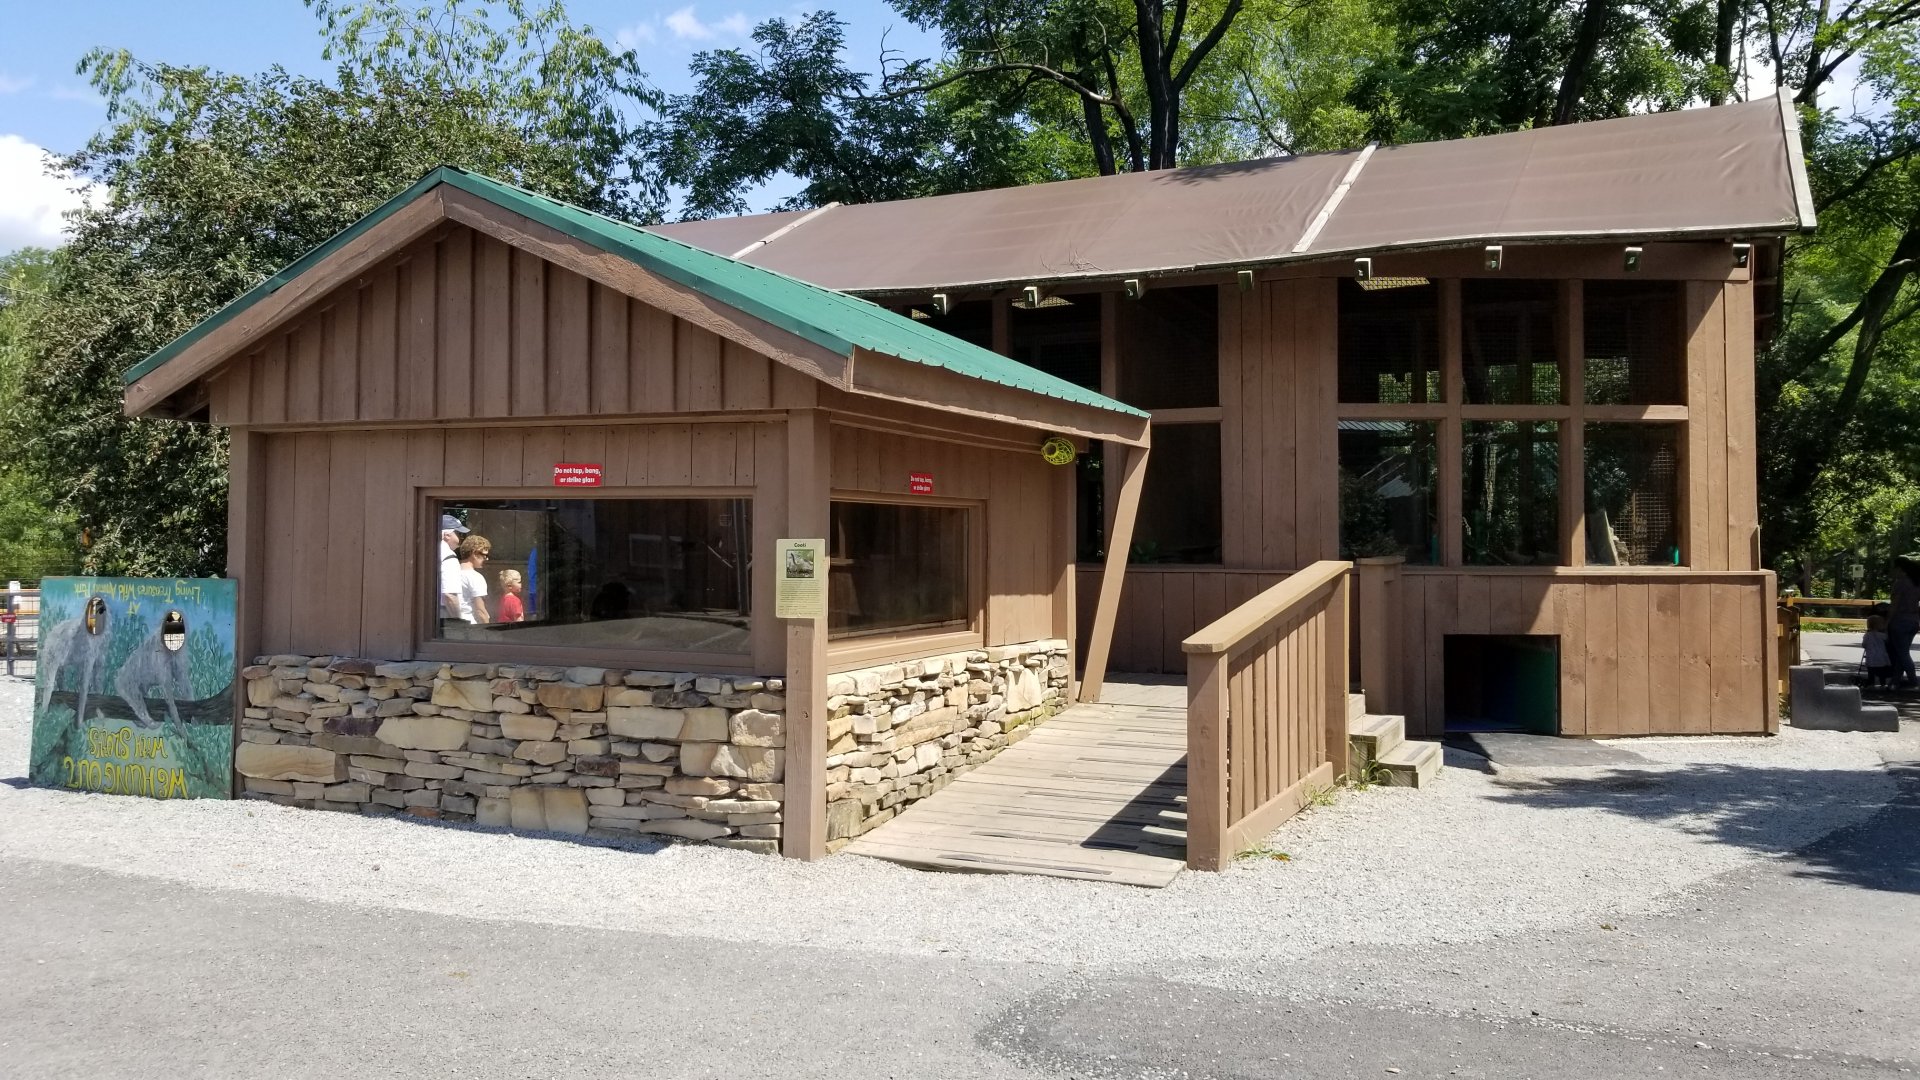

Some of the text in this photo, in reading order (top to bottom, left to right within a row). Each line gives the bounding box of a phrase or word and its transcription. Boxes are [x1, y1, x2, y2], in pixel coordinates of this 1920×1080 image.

[118, 583, 137, 601] Wild
[138, 585, 174, 604] Treasures
[174, 580, 201, 604] Living
[63, 756, 189, 800] WE HUNG OUT
